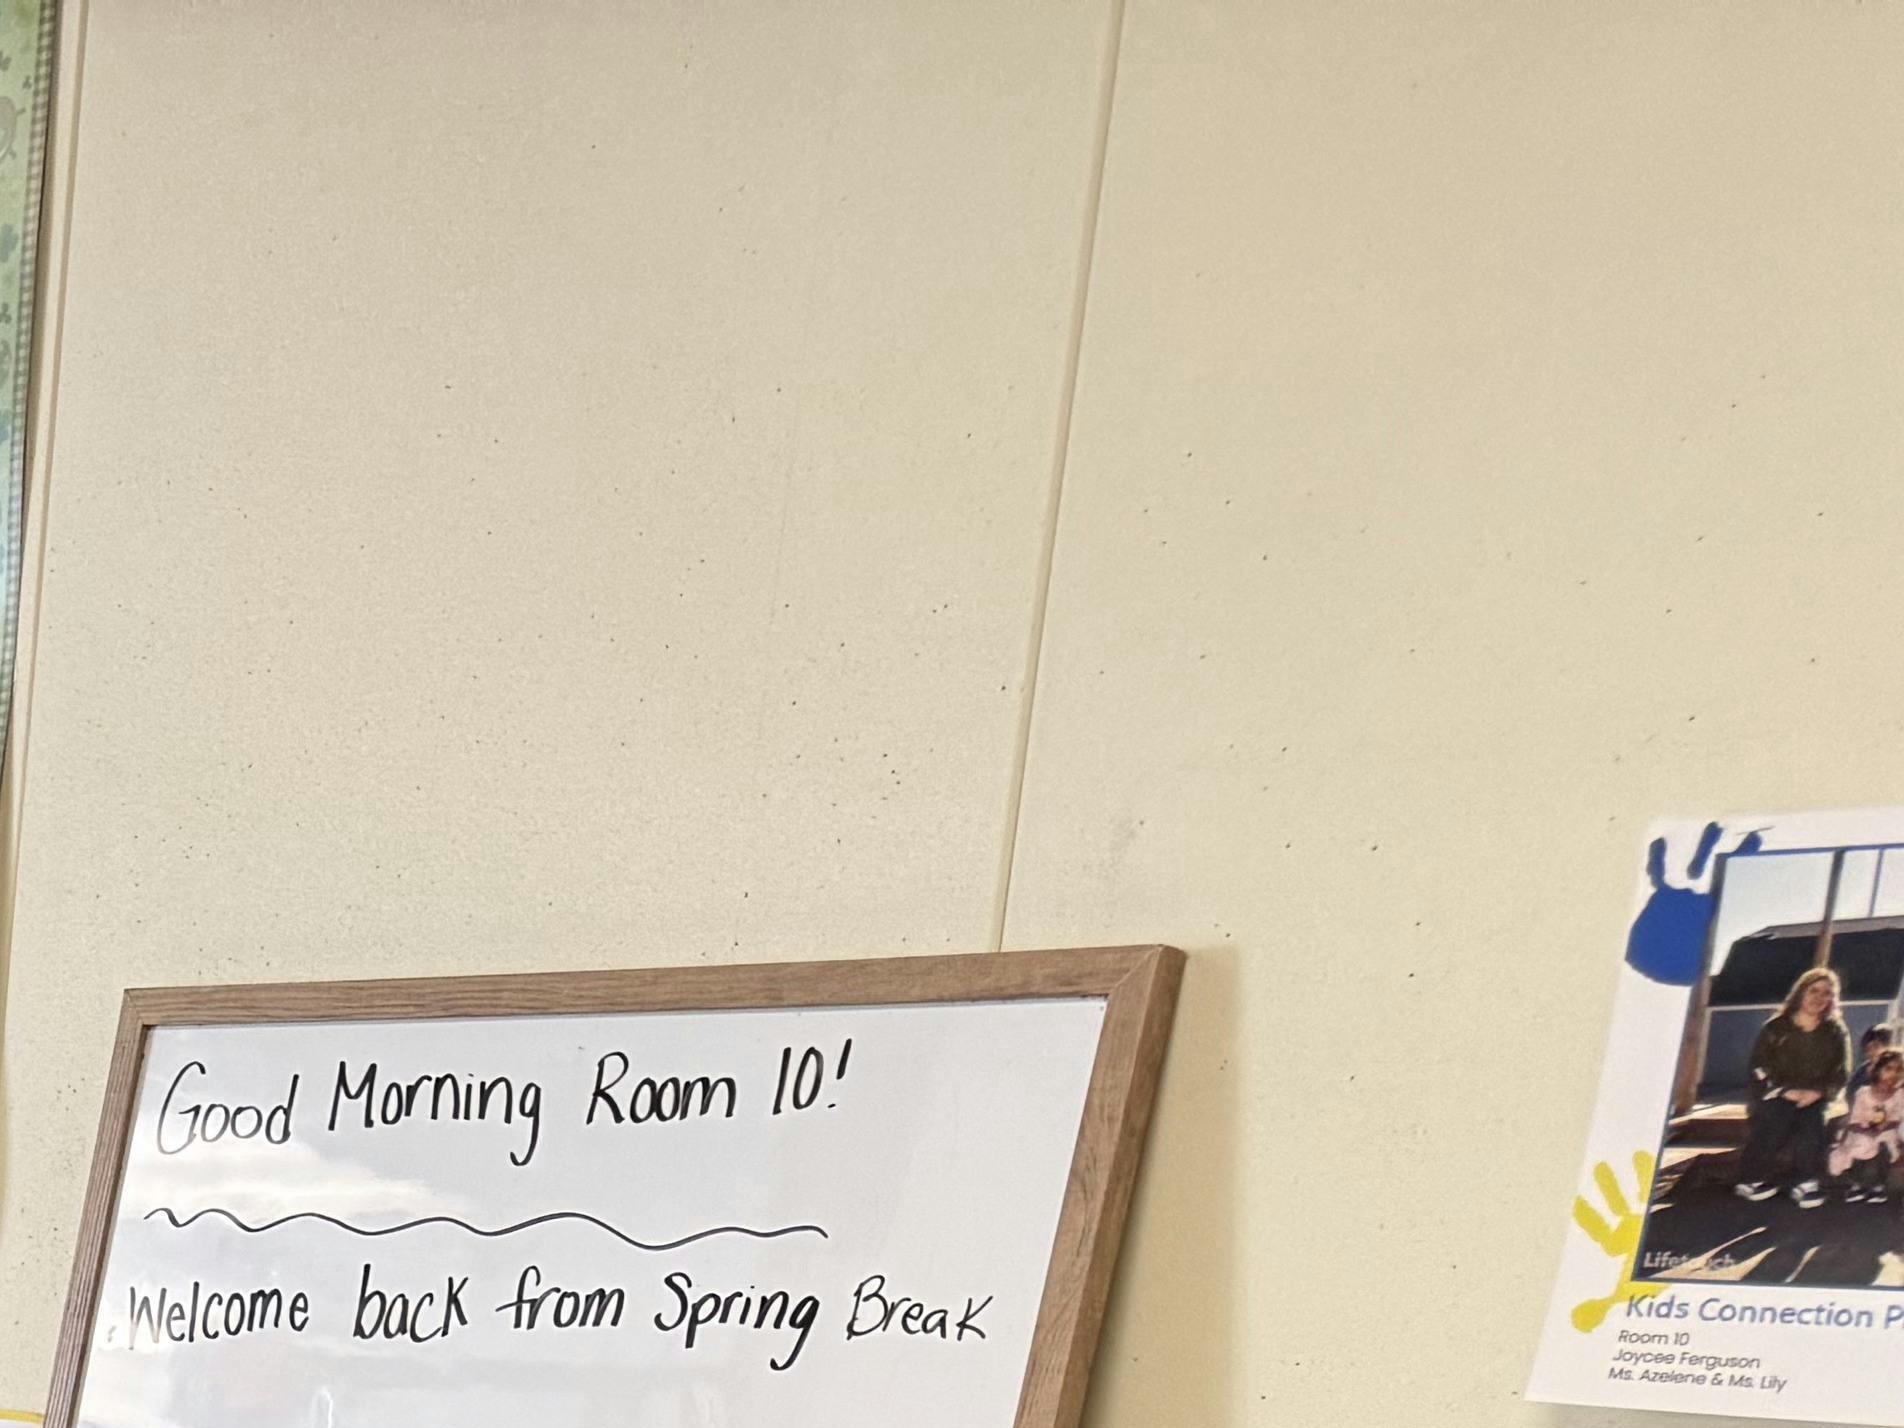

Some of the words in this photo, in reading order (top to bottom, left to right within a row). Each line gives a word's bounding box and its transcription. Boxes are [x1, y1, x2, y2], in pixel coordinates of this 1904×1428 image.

[153, 1060, 301, 1156] Good
[326, 1058, 546, 1167] Morning
[585, 1050, 737, 1126] Room
[770, 1037, 854, 1117] 10!
[126, 1282, 310, 1349] Welcome
[352, 1263, 471, 1343] back
[495, 1263, 626, 1333] from
[653, 1271, 821, 1372] Spring
[845, 1272, 997, 1343] Break
[1626, 1294, 1690, 1319] Kids
[1698, 1297, 1874, 1329] Connection
[1883, 1304, 1904, 1329] P
[1617, 1329, 1670, 1346] Room
[1673, 1331, 1691, 1347] 10
[1612, 1347, 1676, 1366] Joycee
[1678, 1351, 1762, 1371] Ferguson
[1607, 1366, 1633, 1381] Ms.
[1710, 1372, 1725, 1387] &
[1728, 1373, 1755, 1389] Ms.
[1760, 1375, 1789, 1395] Lily
